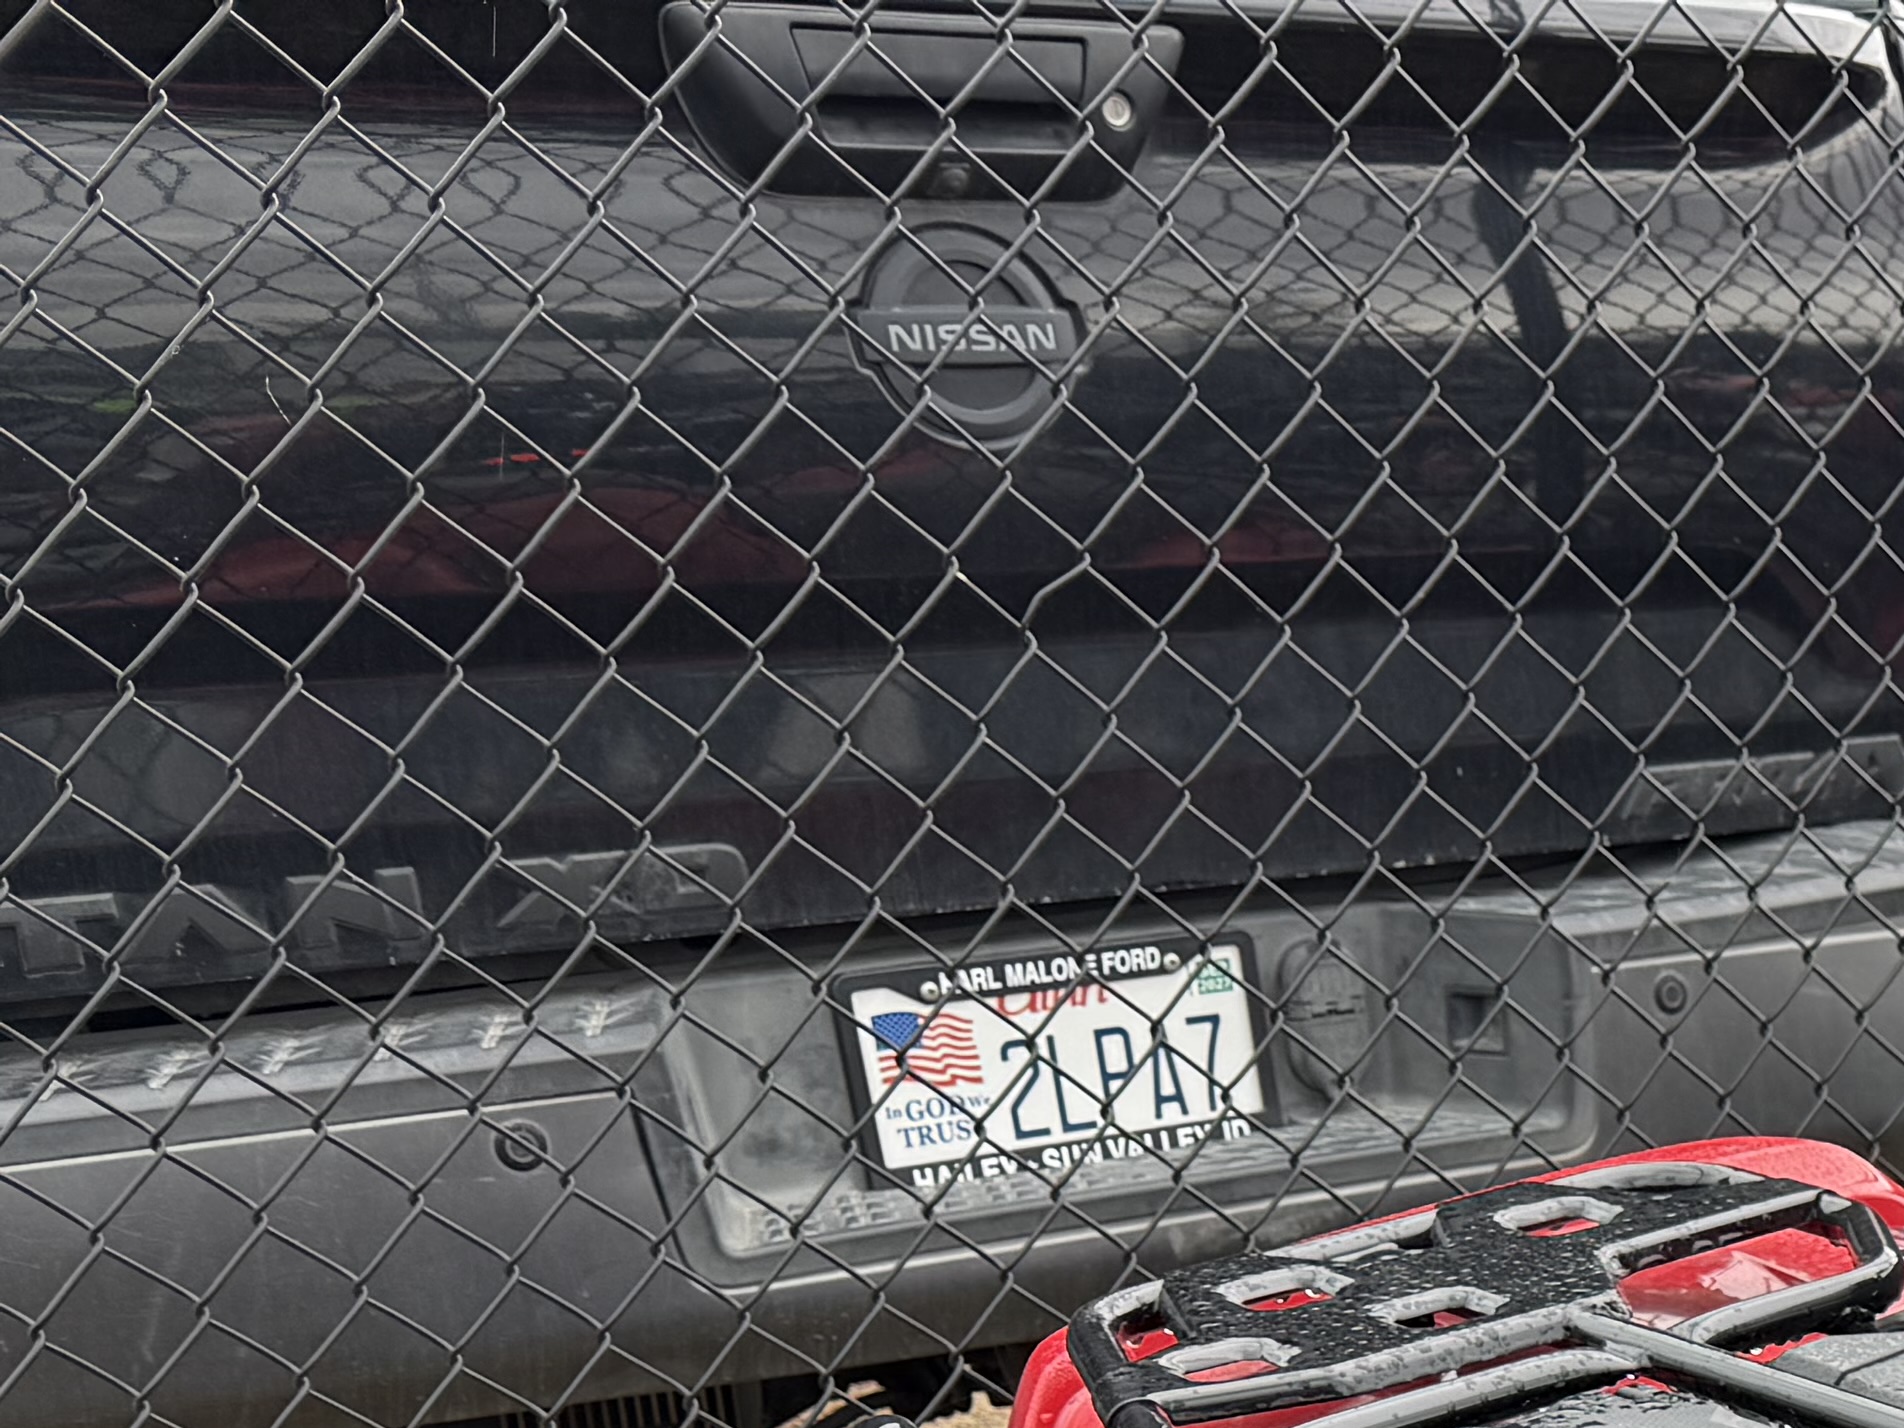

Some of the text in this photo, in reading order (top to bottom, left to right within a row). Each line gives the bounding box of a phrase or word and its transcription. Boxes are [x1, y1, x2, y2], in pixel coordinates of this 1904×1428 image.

[887, 322, 1058, 352] NISSAN
[1003, 953, 1099, 988] MALONE
[1101, 945, 1162, 977] FORD
[1000, 1013, 1221, 1141] 2LPA7
[885, 1105, 903, 1121] In
[896, 1117, 980, 1149] TRUS
